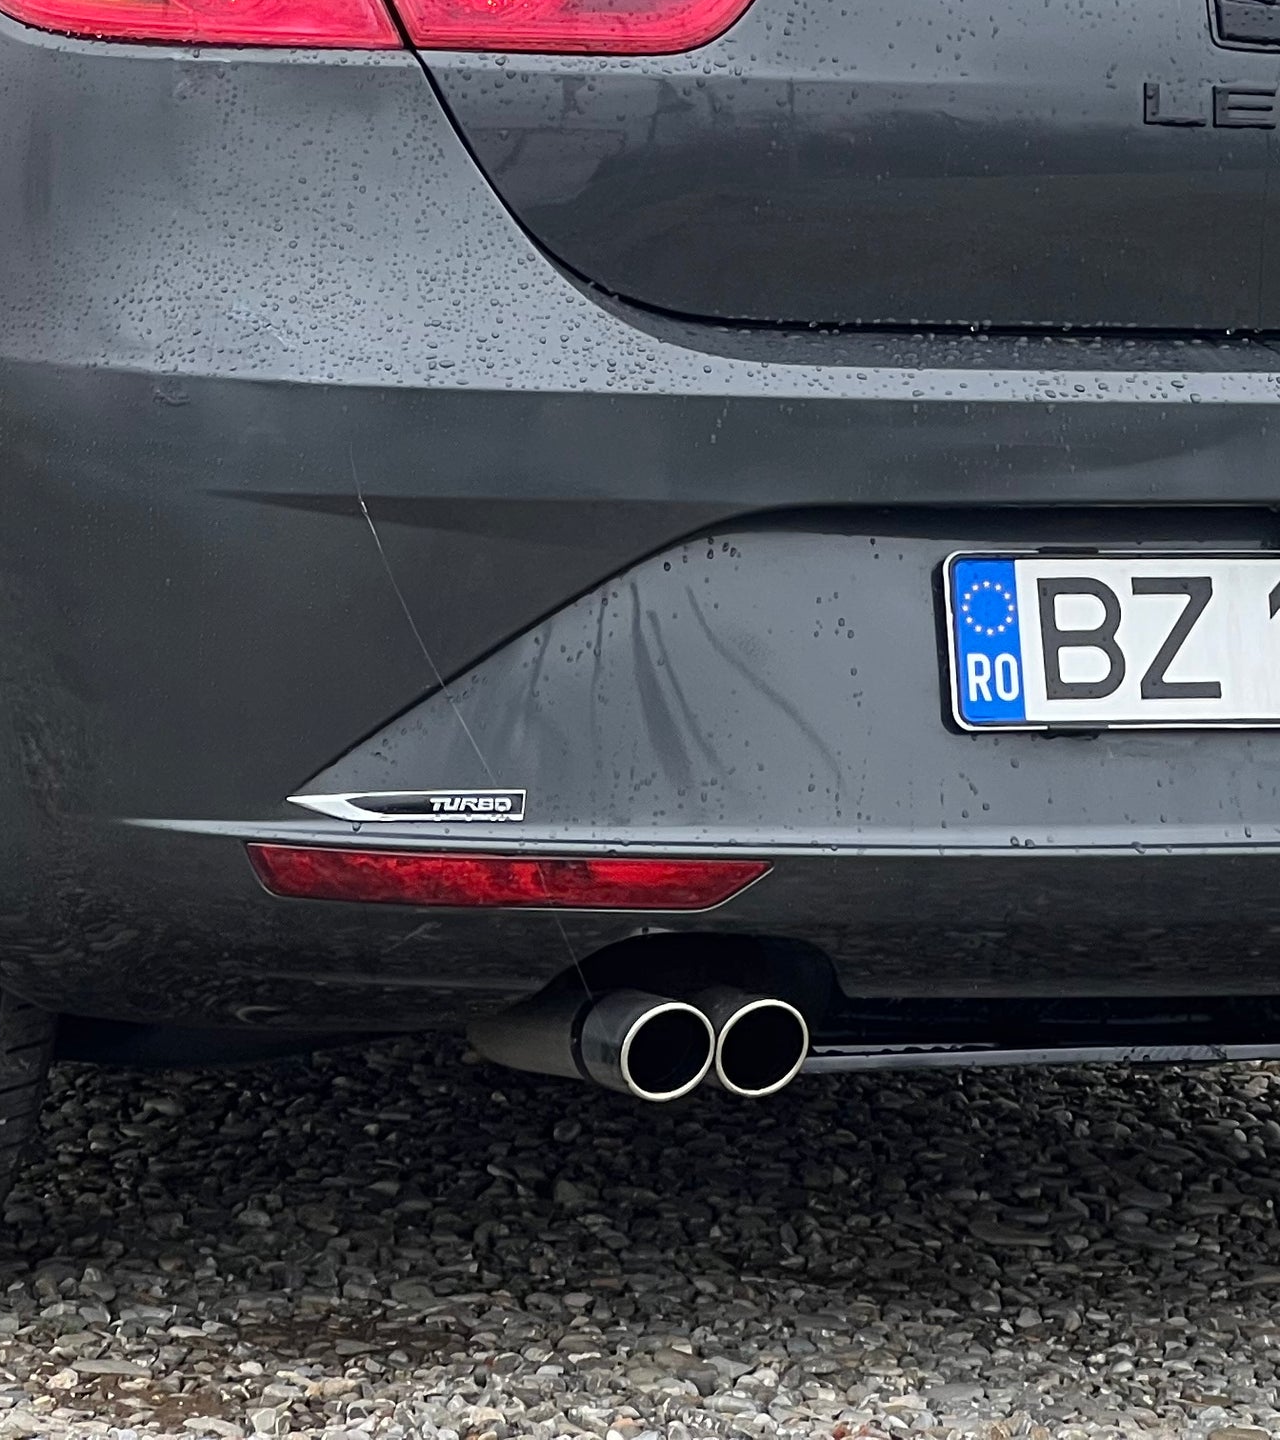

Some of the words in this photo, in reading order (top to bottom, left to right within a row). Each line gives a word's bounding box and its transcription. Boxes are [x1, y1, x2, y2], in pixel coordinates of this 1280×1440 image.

[1036, 576, 1223, 701] BZ
[966, 652, 1020, 702] RO
[429, 797, 513, 813] TURBO
